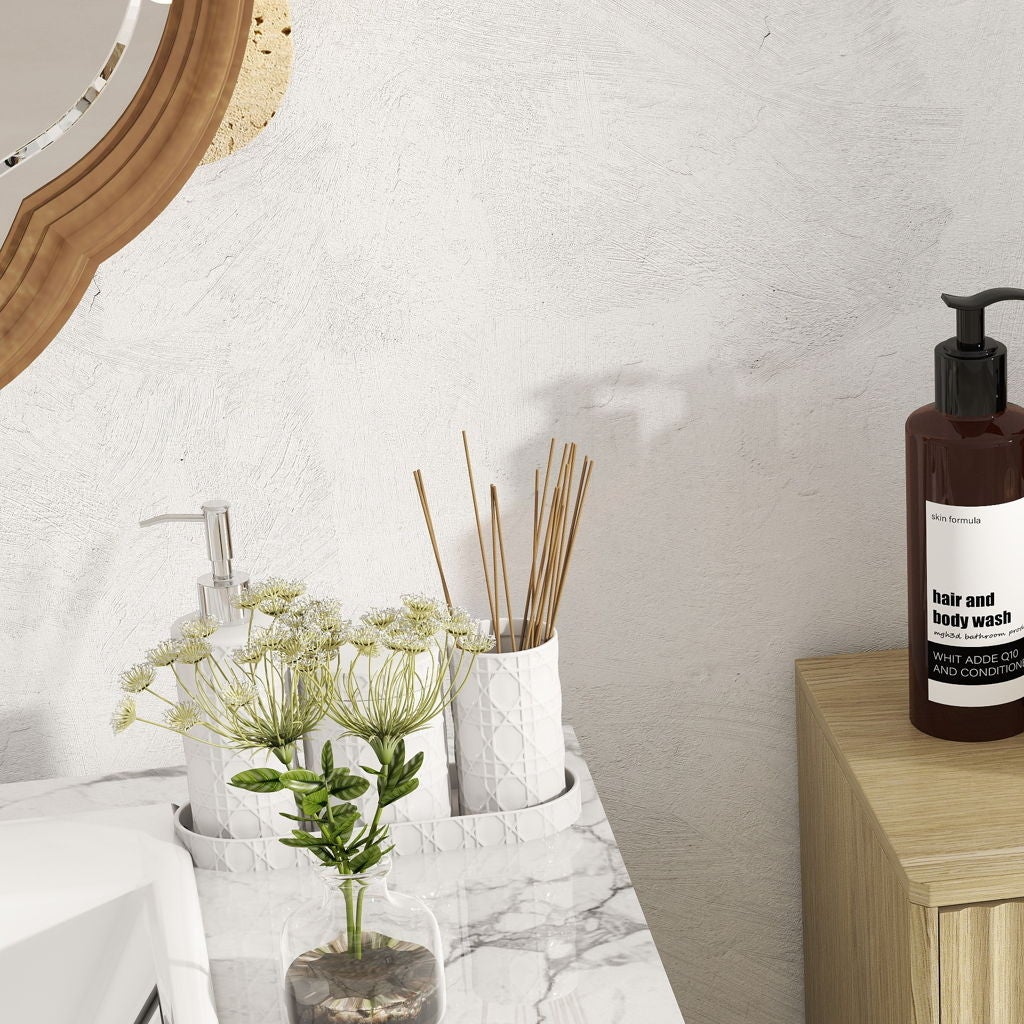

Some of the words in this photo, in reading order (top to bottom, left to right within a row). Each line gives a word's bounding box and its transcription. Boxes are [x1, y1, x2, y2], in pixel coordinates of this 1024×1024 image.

[931, 514, 947, 522] skin
[949, 516, 981, 524] formula
[932, 589, 962, 607] hair
[966, 592, 995, 608] and
[932, 609, 969, 630] body
[972, 610, 1012, 628] wash
[932, 650, 962, 664] WHIT
[965, 653, 999, 665] ADDE
[1001, 648, 1019, 661] Q10
[933, 664, 958, 677] AND
